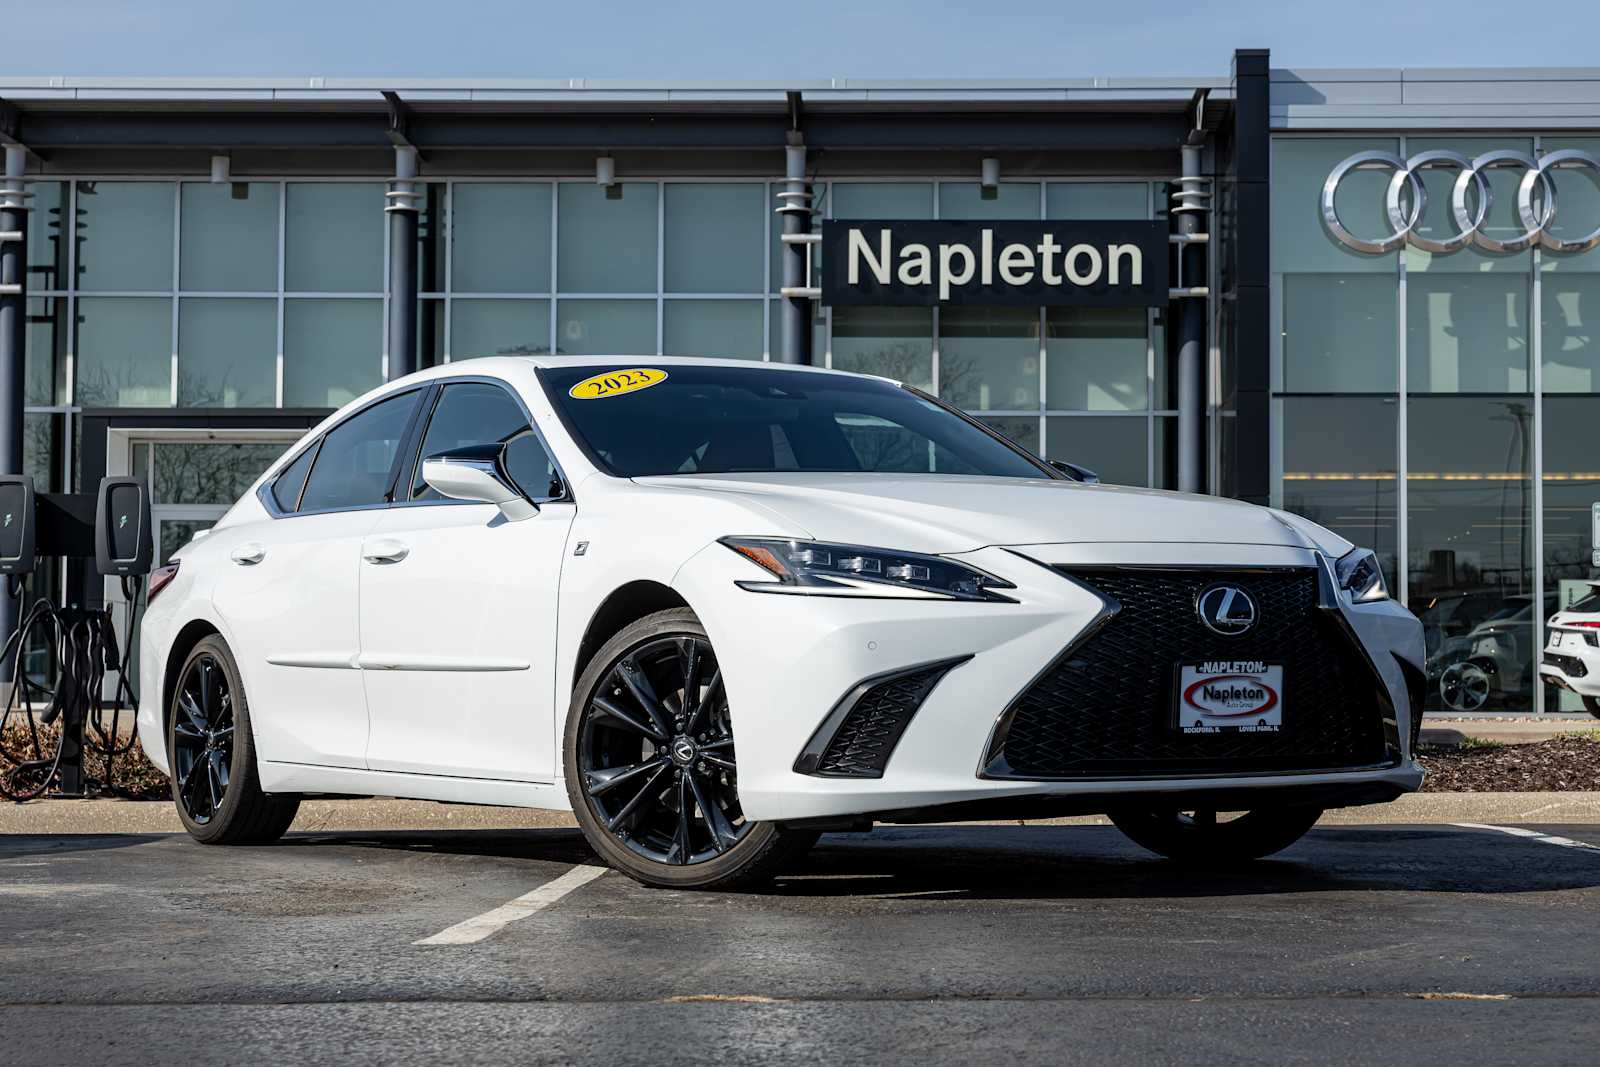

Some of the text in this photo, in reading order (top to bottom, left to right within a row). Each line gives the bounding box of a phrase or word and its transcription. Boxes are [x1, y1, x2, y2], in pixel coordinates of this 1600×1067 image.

[848, 228, 1143, 301] Napleton
[588, 371, 651, 395] 2023
[1203, 685, 1264, 703] Napleton
